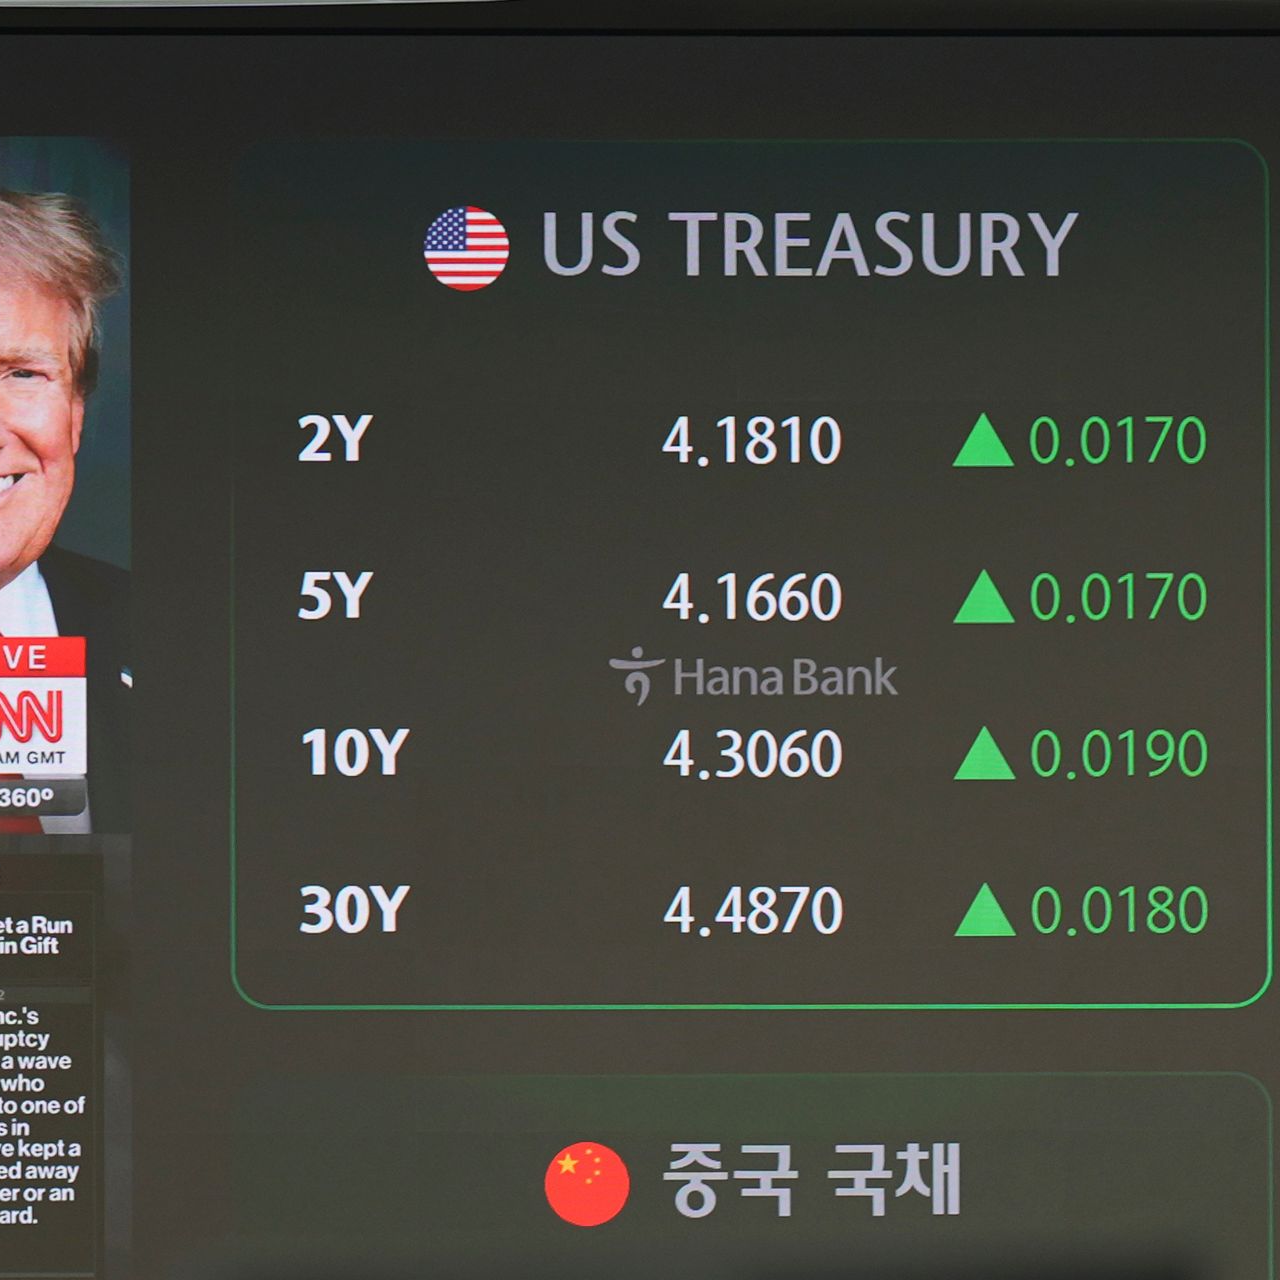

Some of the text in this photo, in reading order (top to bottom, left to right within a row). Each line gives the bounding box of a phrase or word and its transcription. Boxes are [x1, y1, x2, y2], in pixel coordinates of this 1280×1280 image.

[543, 210, 1079, 277] US TREASURY
[298, 414, 1207, 467] 2Y 4.1810 0.0170
[297, 571, 1207, 624] 5Y 4.1660 0.0170
[674, 656, 899, 696] Hana Bank
[26, 750, 66, 765] GMT
[302, 728, 1208, 781] 10Y 4.3060 0.0190
[299, 885, 1209, 937] 30Y 4.4870 0.0180
[15, 919, 30, 935] a
[31, 915, 73, 934] Run
[19, 935, 59, 955] Gift
[0, 1055, 14, 1070] a
[17, 1055, 72, 1070] wave
[0, 1073, 45, 1092] who
[20, 1099, 61, 1115] one
[63, 1095, 86, 1115] of
[11, 1117, 30, 1136] in
[17, 1138, 65, 1161] kept
[67, 1142, 82, 1157] a
[24, 1164, 80, 1184] away
[663, 1142, 960, 1219] 중국 국채
[22, 1187, 46, 1202] or
[48, 1187, 75, 1202] an
